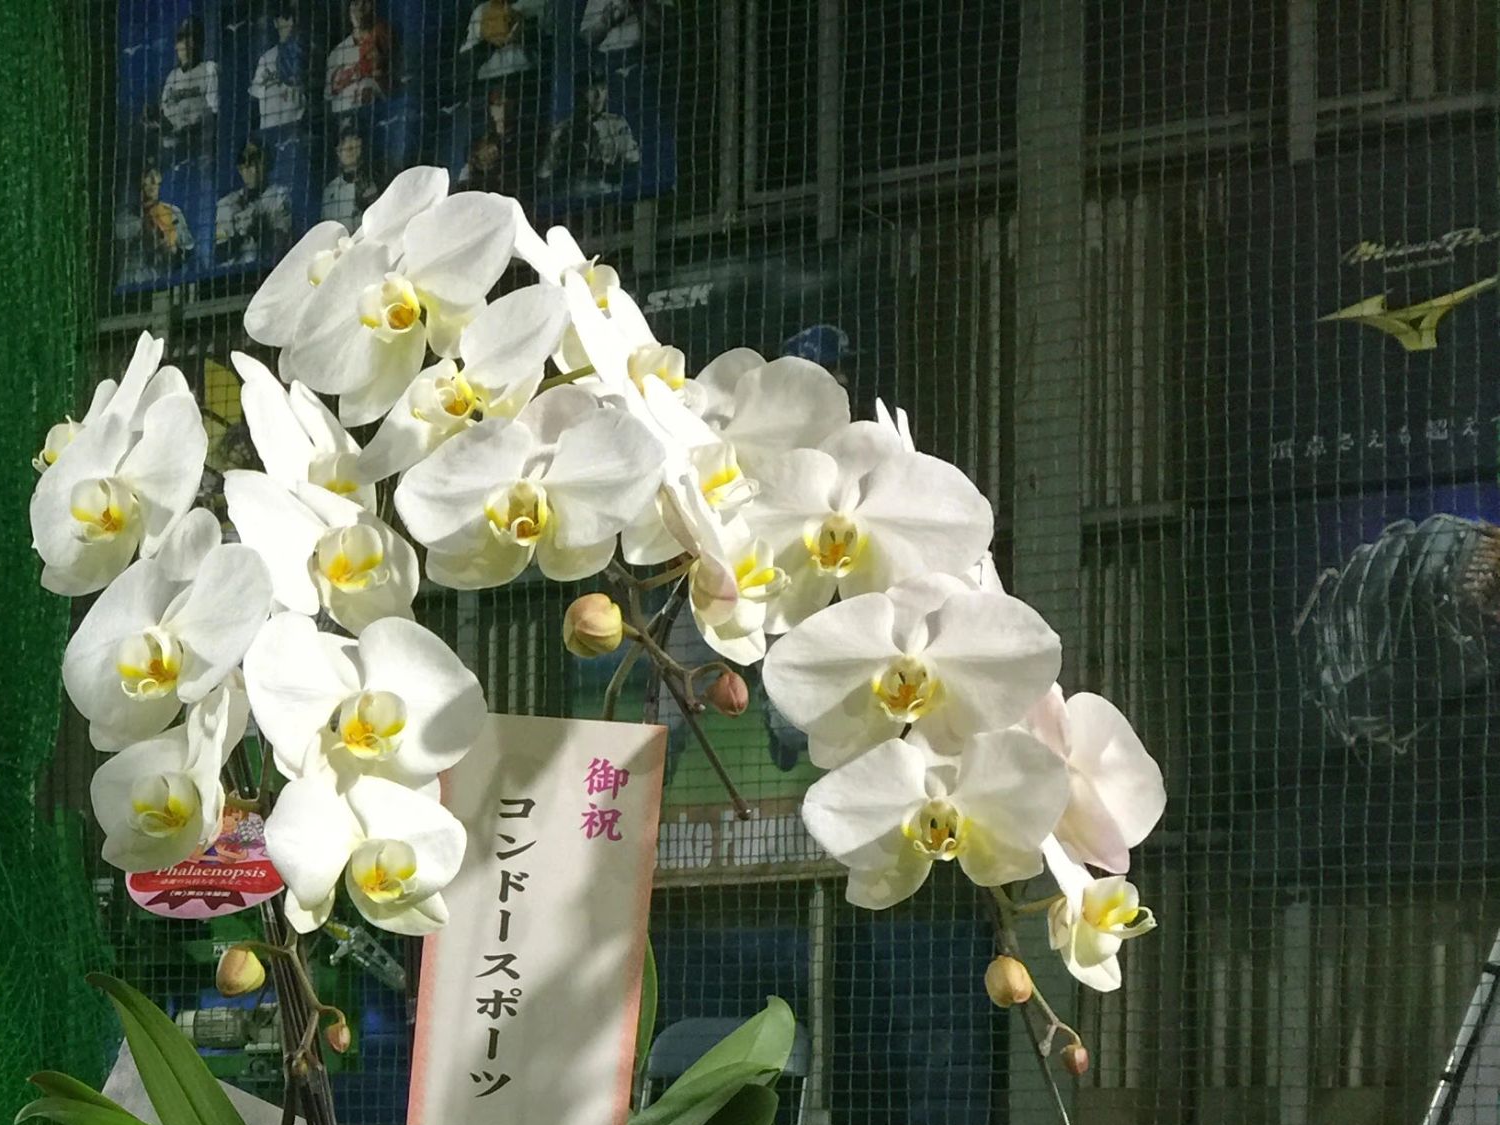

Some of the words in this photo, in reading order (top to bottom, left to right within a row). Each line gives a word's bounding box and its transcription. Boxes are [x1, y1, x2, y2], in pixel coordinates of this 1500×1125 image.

[643, 283, 714, 314] SSK
[580, 757, 629, 841] 御祝
[653, 813, 713, 869] uke
[156, 864, 267, 880] Phalaenopsis
[470, 798, 537, 1098] コンドースポーツ
